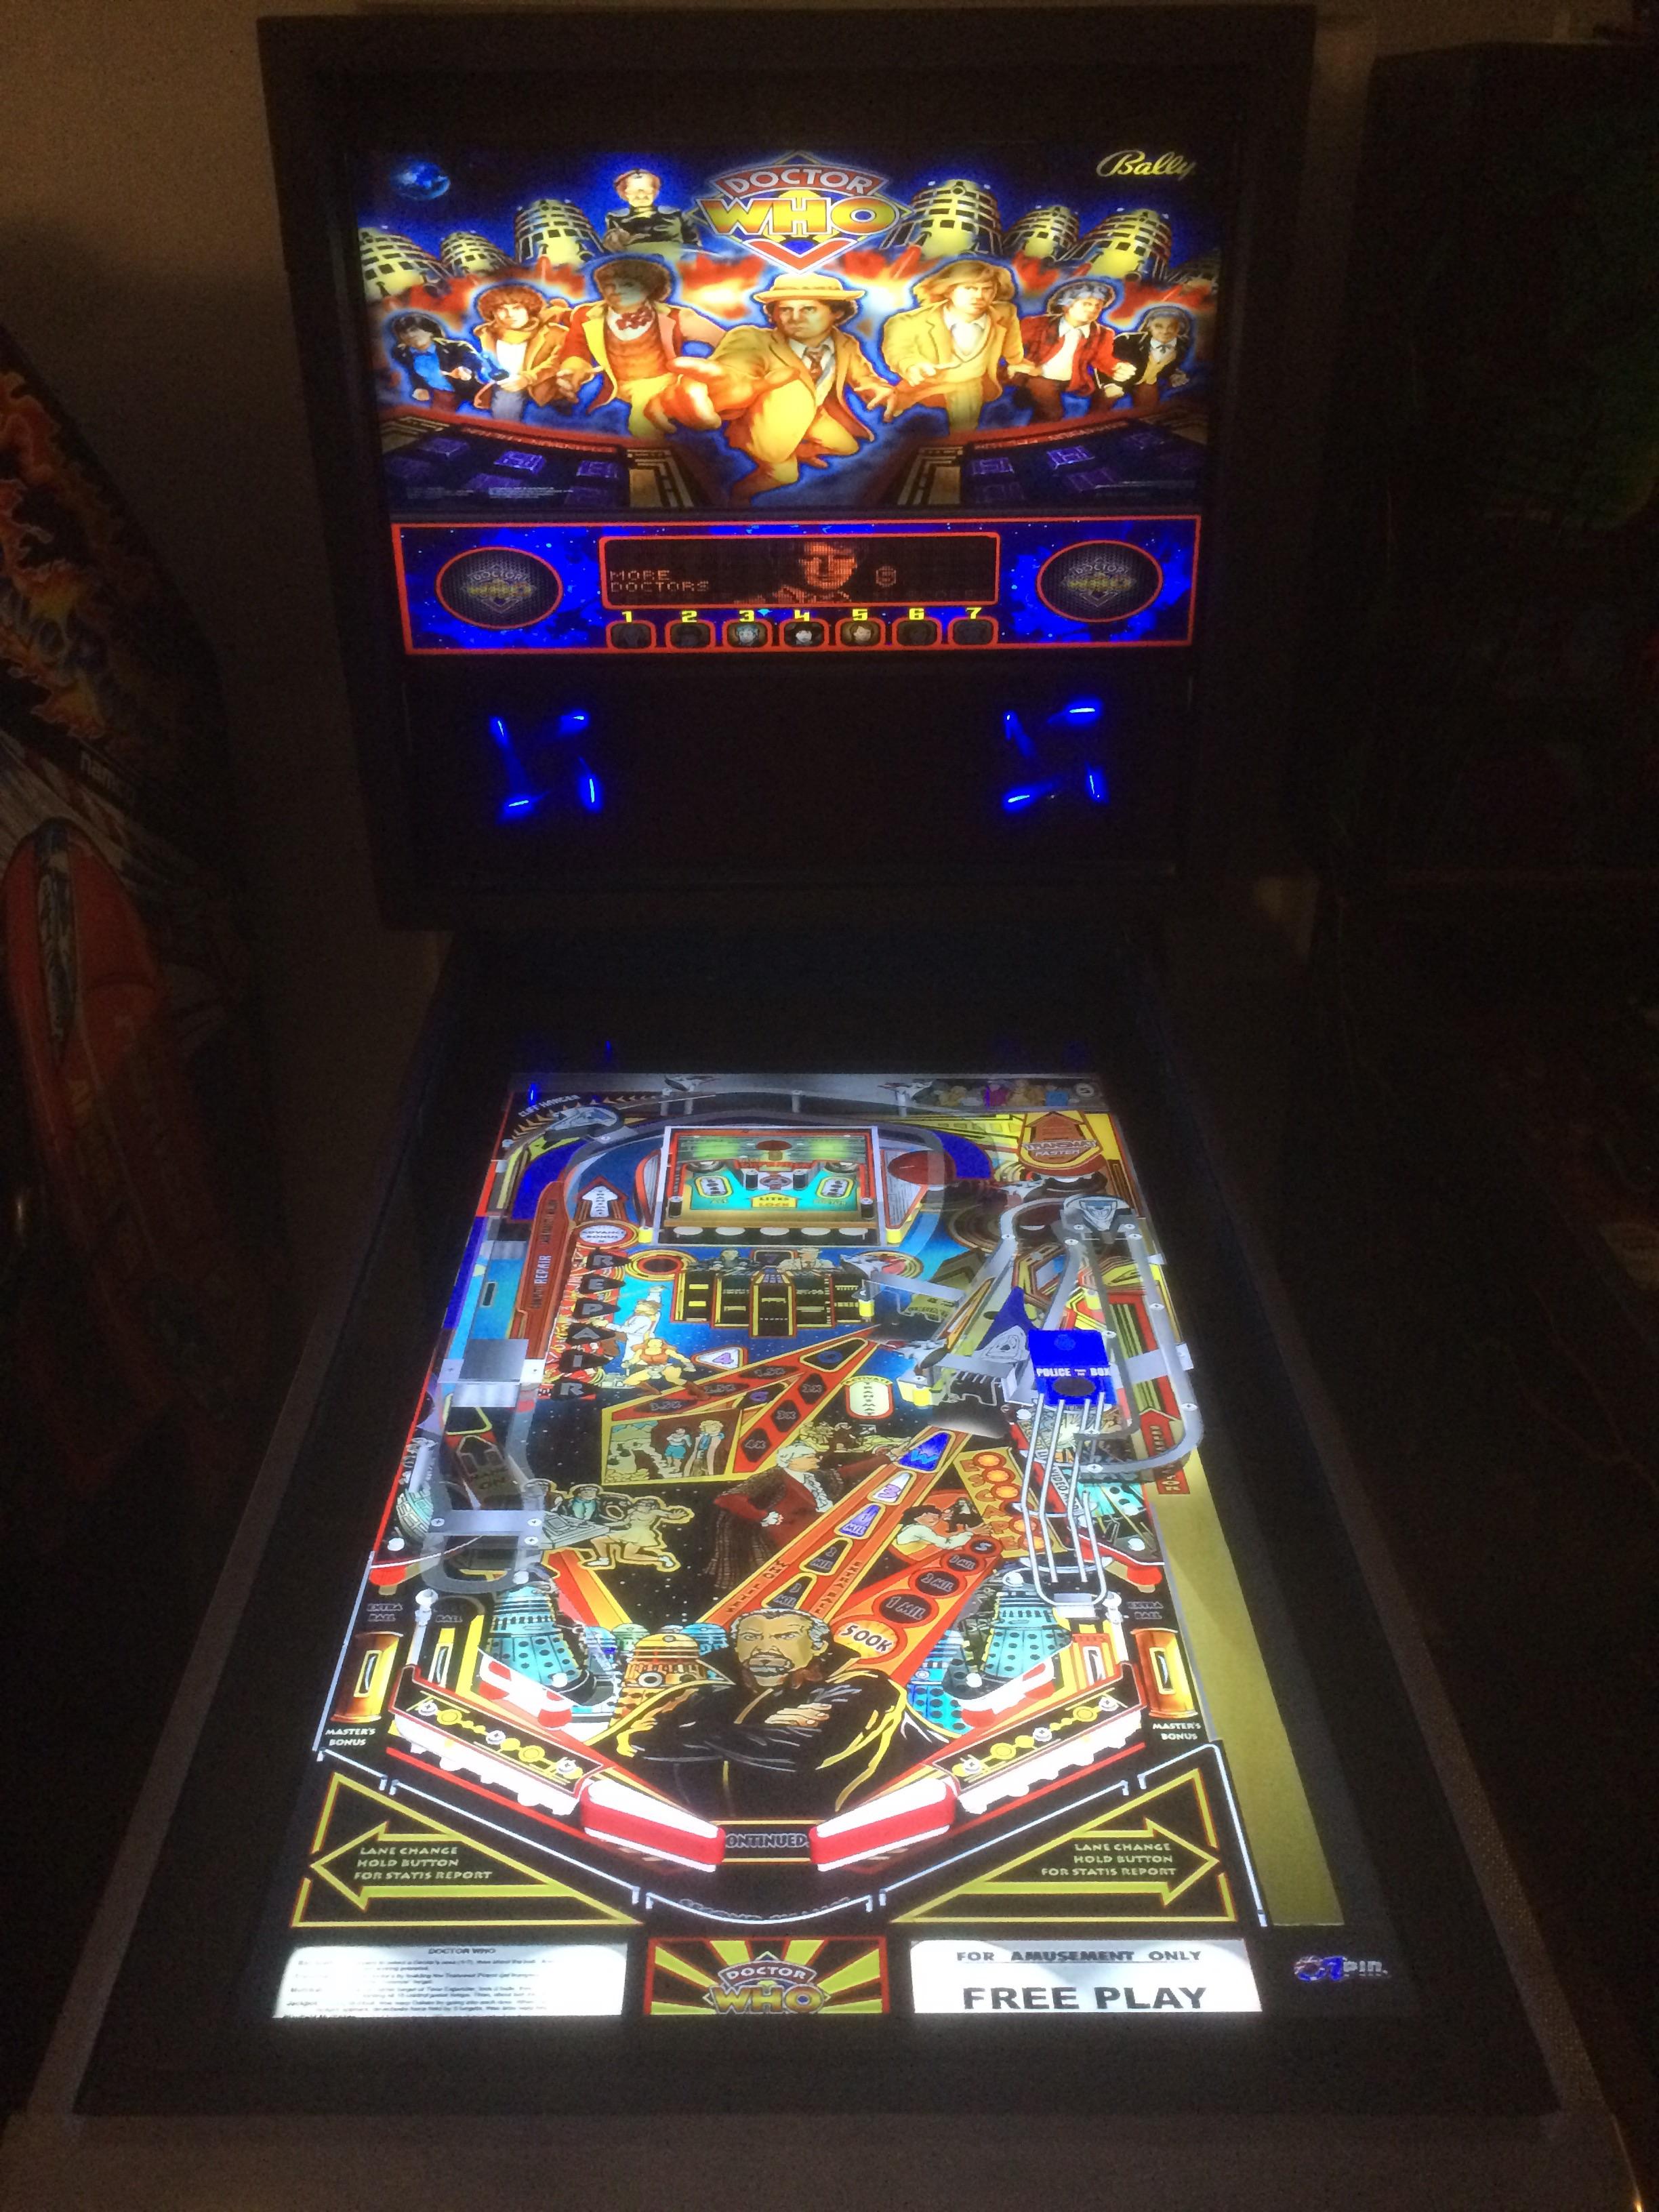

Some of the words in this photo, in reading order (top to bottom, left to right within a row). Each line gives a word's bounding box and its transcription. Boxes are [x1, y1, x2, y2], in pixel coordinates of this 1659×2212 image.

[1097, 150, 1197, 181] Bally
[729, 168, 874, 194] DOCTOR
[697, 197, 900, 236] WHO
[611, 570, 670, 581] MORE
[611, 581, 709, 593] DOCTORS
[621, 611, 634, 622] 1
[681, 611, 697, 622] 2
[739, 610, 755, 622] 3
[794, 610, 810, 621] 4
[853, 609, 869, 621] 5
[909, 609, 925, 620] 6
[966, 607, 982, 619] 7
[712, 1352, 734, 1364] 4
[1036, 1367, 1071, 1377] POLICE
[1090, 1367, 1111, 1377] BOX
[843, 1523, 865, 1536] MIL
[897, 1601, 926, 1621] MIL
[840, 1624, 893, 1654] 500K
[325, 1727, 376, 1736] MASTER'S
[1152, 1721, 1202, 1731] MASTER'S
[328, 1738, 367, 1746] BONUS
[1160, 1732, 1199, 1741] BONUS
[725, 1832, 806, 1849] ONTINUED
[360, 1846, 396, 1856] LANE
[399, 1846, 458, 1856] CHANGE
[1075, 1843, 1111, 1851] LANE
[1113, 1843, 1172, 1851] CHANGE
[356, 1858, 398, 1868] HOLD
[401, 1858, 459, 1868] BUTTON
[1073, 1855, 1113, 1864] HOLD
[1115, 1855, 1173, 1864] BUTTON
[353, 1871, 382, 1881] FOR
[385, 1871, 432, 1881] STATIS
[434, 1870, 493, 1881] REPORT
[1041, 1867, 1069, 1877] FOR
[1071, 1867, 1118, 1877] STATIS
[1120, 1867, 1176, 1877] REPORT
[956, 1950, 995, 1962] FOR
[1010, 1950, 1135, 1962] AMUSEMENT
[1147, 1950, 1202, 1961] ONLY
[726, 1966, 807, 1981] DOCTOR
[710, 1985, 827, 2014] WHO
[962, 1986, 1080, 2010] FREE
[1094, 1986, 1208, 2010] PLAY
